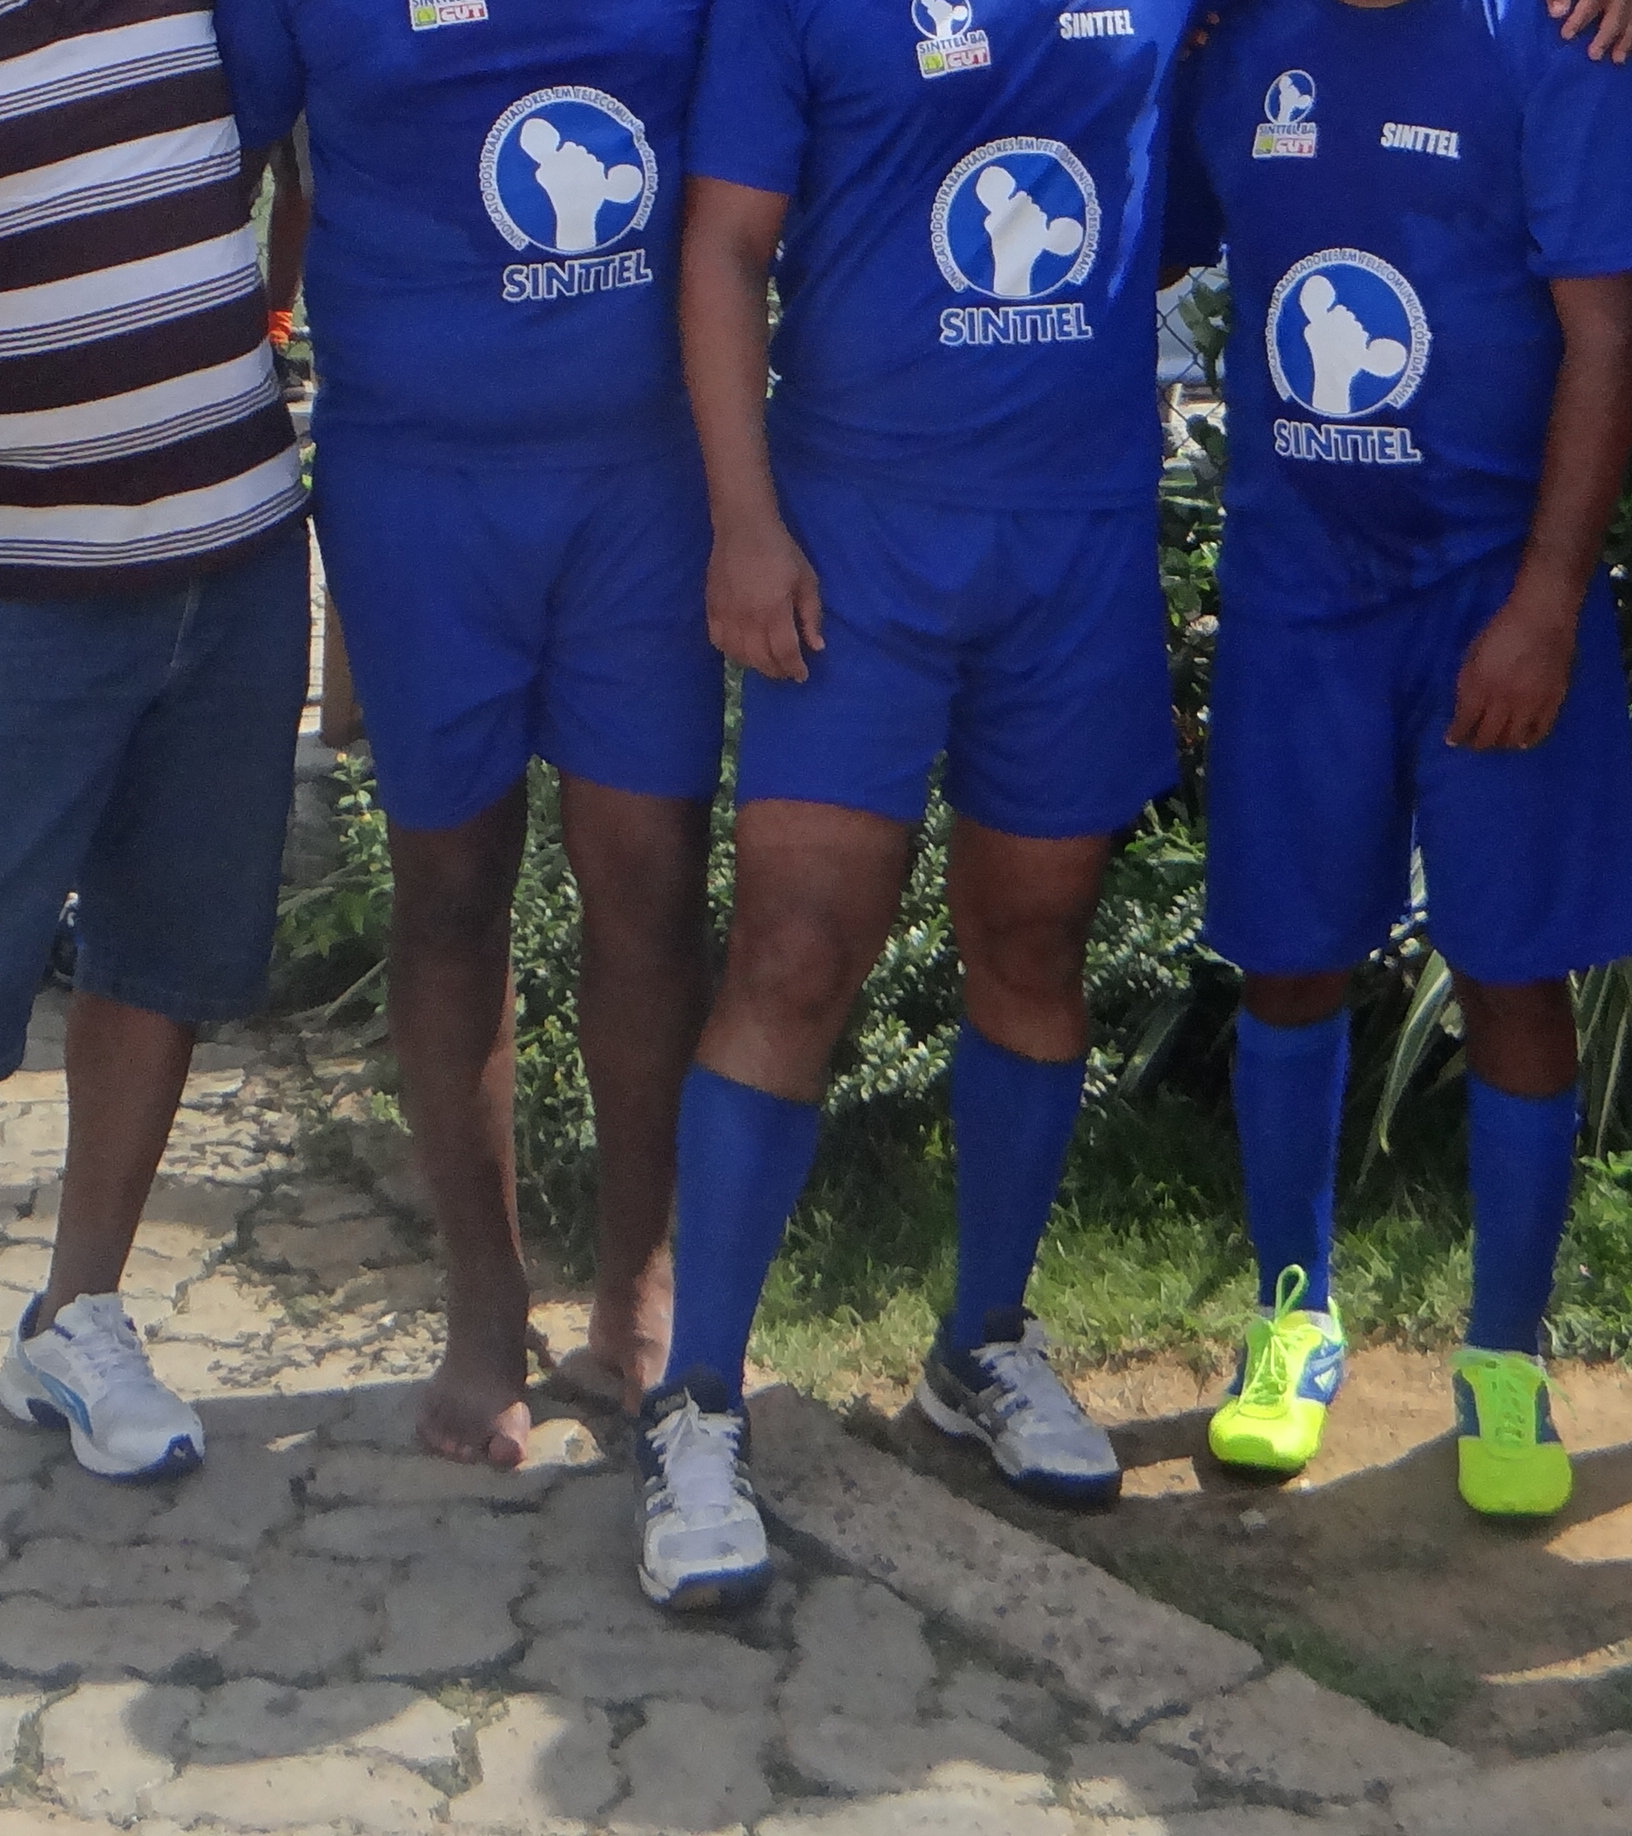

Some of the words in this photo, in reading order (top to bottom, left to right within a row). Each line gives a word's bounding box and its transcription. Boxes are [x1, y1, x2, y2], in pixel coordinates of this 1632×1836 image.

[440, 4, 484, 21] CUT
[1058, 9, 1135, 41] SINTTEL
[918, 36, 968, 54] SINTTEL
[969, 31, 987, 44] BA
[948, 48, 988, 68] CUT
[555, 87, 572, 100] EM
[483, 88, 553, 161] TRABALHADORES
[1275, 138, 1313, 153] CUT
[1380, 122, 1460, 159] SINTTEL
[481, 161, 494, 190] DOS
[937, 139, 1014, 206] TRABALHADORES
[931, 205, 945, 233] DOS
[502, 249, 653, 302] SINTTEL
[939, 303, 1093, 345] SINTTEL
[1274, 418, 1422, 464] SINTTEL
